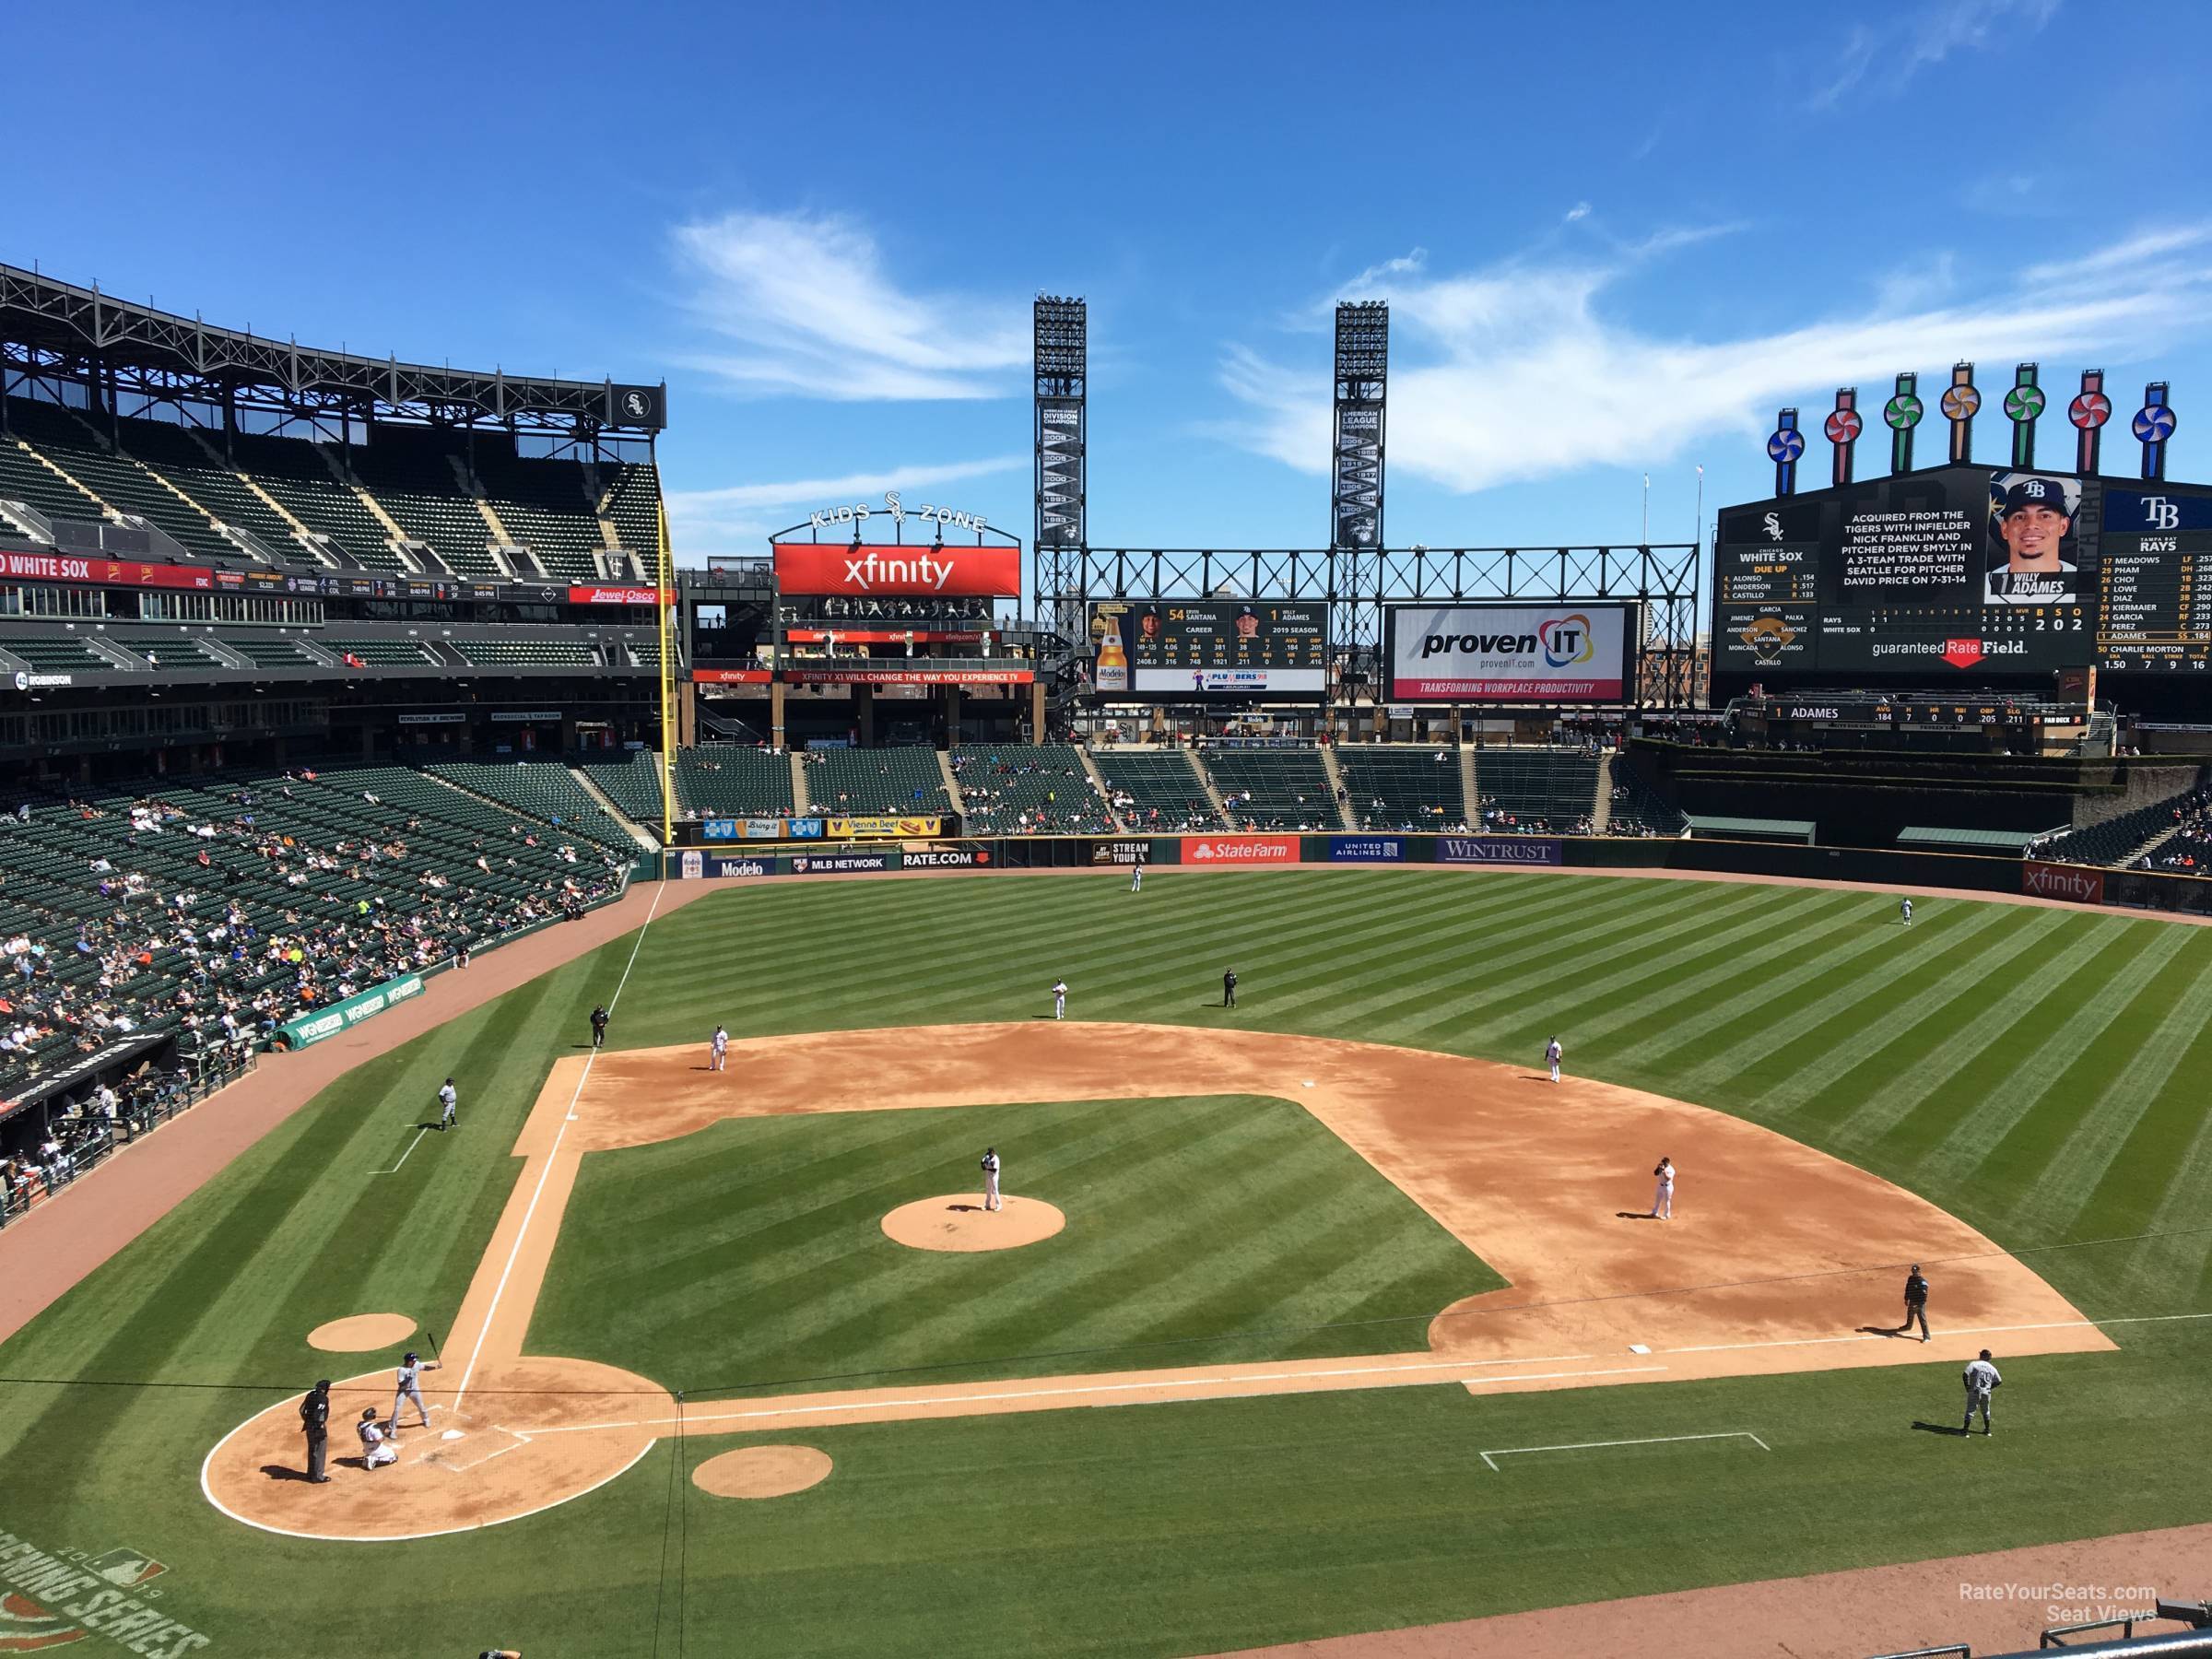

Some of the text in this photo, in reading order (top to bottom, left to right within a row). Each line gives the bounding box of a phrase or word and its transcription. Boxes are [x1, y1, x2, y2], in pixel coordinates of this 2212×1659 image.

[810, 503, 870, 530] KIDS
[919, 504, 988, 534] ZONE
[1852, 513, 1907, 524] ACQUIRED
[2140, 497, 2180, 530] TB
[1845, 522, 1971, 534] TIGERS WITH INFIELDER
[1853, 533, 1961, 544] NICK FRANKLIN AND
[1841, 546, 1885, 554] PITCHER
[1888, 545, 1920, 553] DREW
[1923, 544, 1958, 552] SMYLY
[2140, 541, 2177, 552] RAYS
[1739, 552, 1804, 562] WHITE SOX
[1847, 554, 1965, 565] A 3-TEAM TRADE WITH
[2114, 557, 2160, 565] MEADOWS
[8, 556, 57, 576] WHITE
[61, 558, 89, 578] SOX
[844, 553, 955, 590] xfinity
[1775, 565, 1788, 573] UP
[1847, 565, 1964, 575] SEATLLE FOR PITCHER
[1843, 575, 1967, 585] DAVID PRICE ON 7-31-14
[2014, 573, 2040, 582] WILLY
[2000, 573, 2009, 594] 1
[2011, 581, 2065, 594] ADAMES
[1169, 609, 1184, 620] 54
[2037, 608, 2043, 617] B
[2035, 619, 2082, 630] 2 0 2
[1421, 630, 1580, 659] proven IT
[1873, 641, 1945, 656] guaranteed
[1947, 641, 1979, 654] Rate
[1480, 659, 1535, 670] provenIT.com
[2104, 661, 2205, 669] 1.50 7 9 16
[29, 675, 72, 686] ROBINSON
[719, 671, 745, 682] xfinity
[845, 673, 865, 681] WILL
[867, 673, 903, 681] CHANGE
[905, 673, 922, 681] THE
[924, 673, 941, 681] WAY
[943, 673, 960, 681] YOU
[1420, 682, 1594, 693] TRANSFORMING WORKPLACE PRODUCTIVITY
[1776, 708, 1839, 719] 1 ADAMES
[747, 821, 771, 831] Bring
[847, 819, 899, 829] Vienna Beef
[1113, 842, 1149, 853] STREAM
[904, 853, 971, 865] RATE.COM
[1113, 853, 1136, 863] YOUR
[722, 862, 763, 877] Modelo
[812, 858, 883, 870] MLB NETWORK
[2027, 867, 2098, 900] xfinity
